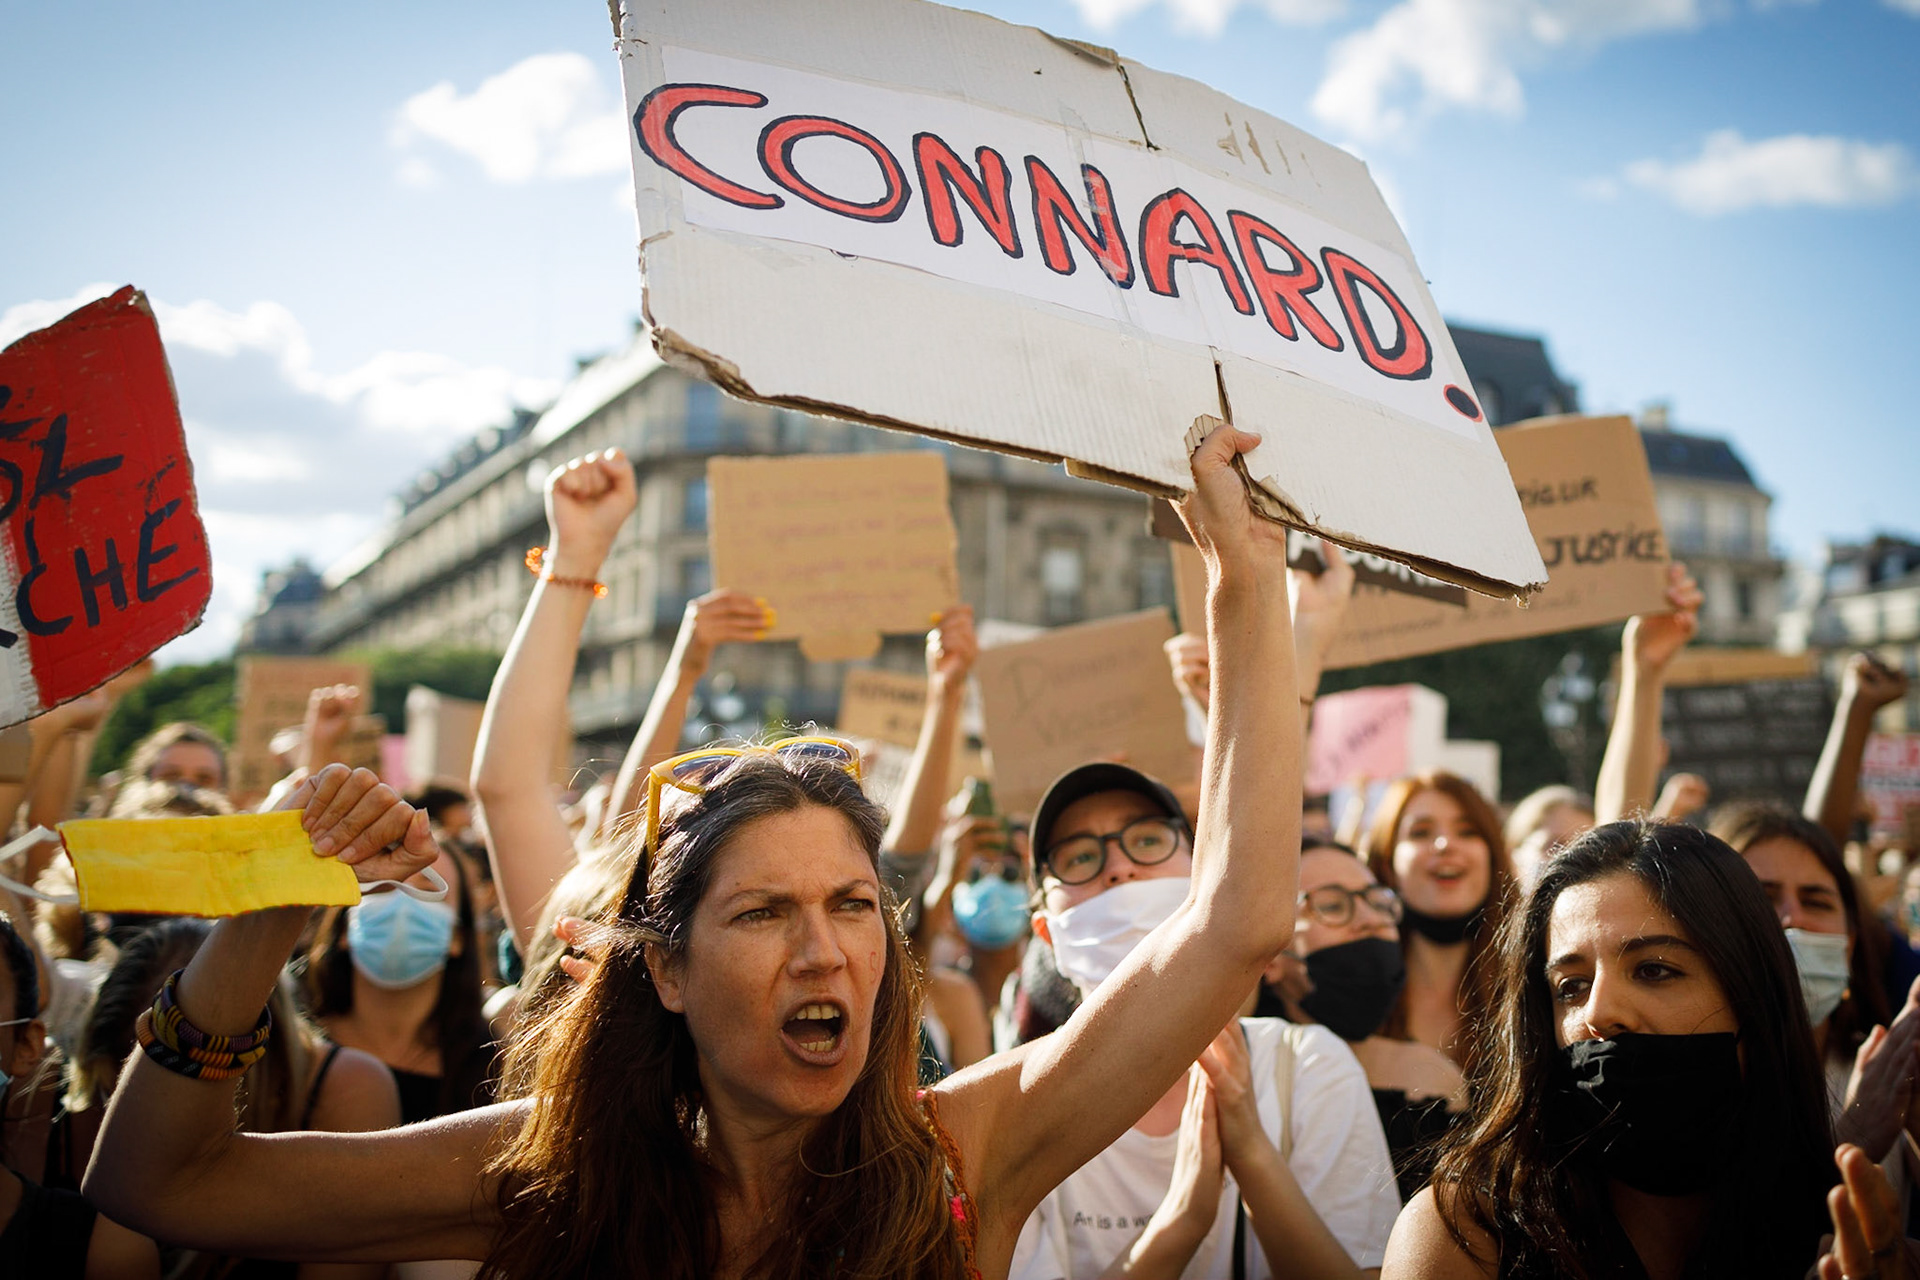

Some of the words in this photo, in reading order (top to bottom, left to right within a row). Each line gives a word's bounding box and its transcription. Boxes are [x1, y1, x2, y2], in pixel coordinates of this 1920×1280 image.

[0, 498, 200, 648] CHE
[1096, 1213, 1112, 1230] is
[1116, 1216, 1128, 1229] a
